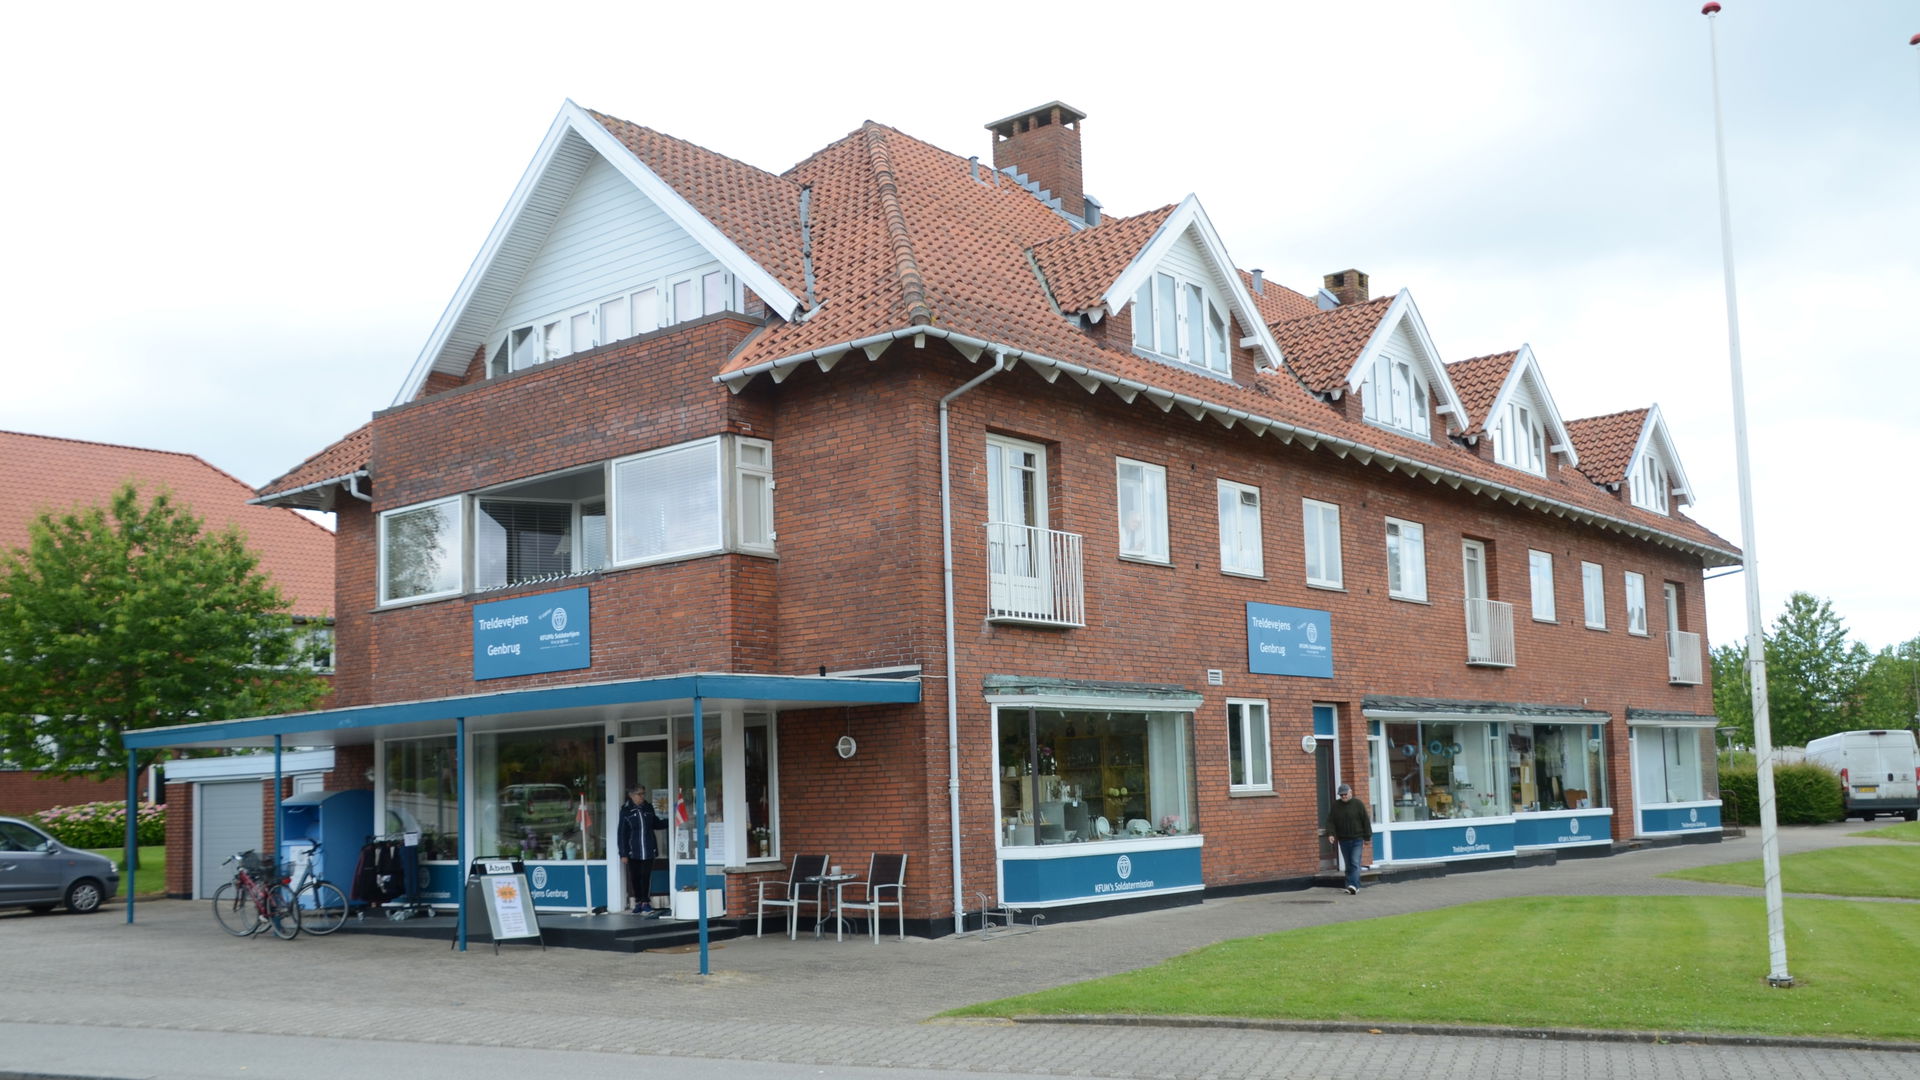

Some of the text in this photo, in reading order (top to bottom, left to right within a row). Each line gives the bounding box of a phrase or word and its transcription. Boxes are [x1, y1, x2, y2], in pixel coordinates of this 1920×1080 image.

[478, 614, 529, 630] Treldevejens
[1252, 616, 1291, 632] Treldevejens
[487, 643, 521, 656] Genbrug
[1260, 641, 1286, 657] Genbrug
[545, 888, 569, 900] Genbrug
